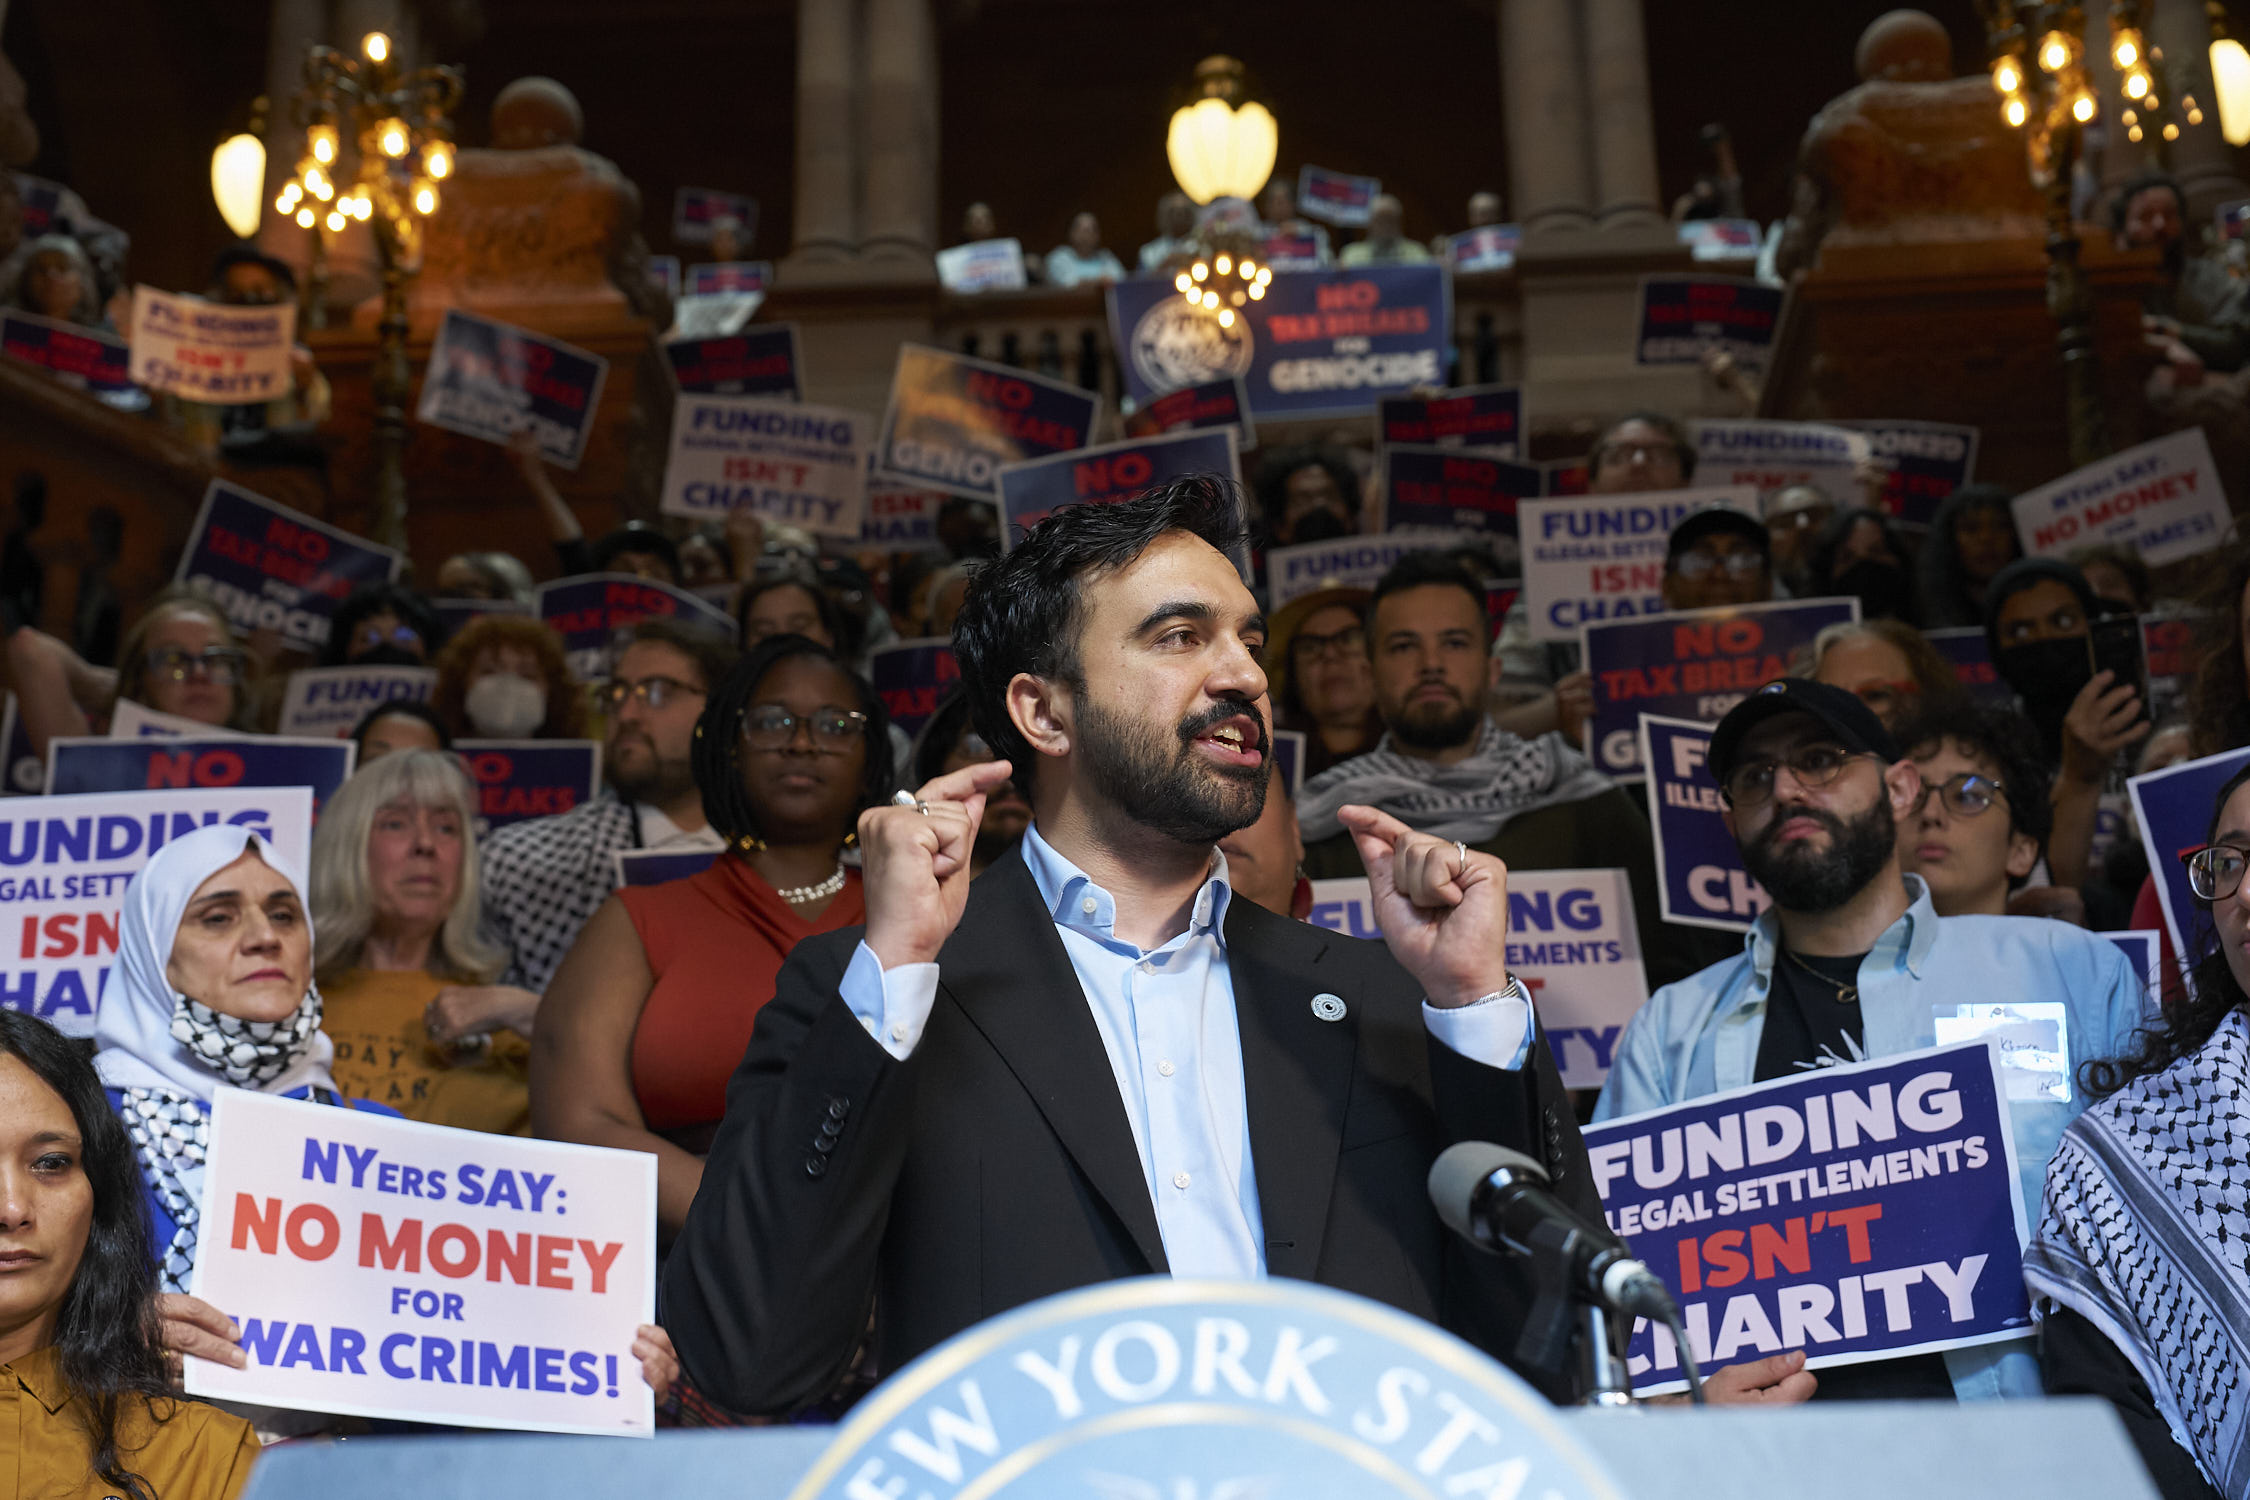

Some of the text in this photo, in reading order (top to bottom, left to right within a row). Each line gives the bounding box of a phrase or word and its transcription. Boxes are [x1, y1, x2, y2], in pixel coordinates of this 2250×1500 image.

[1315, 279, 1381, 312] NO
[966, 368, 1034, 410] NO
[1268, 348, 1441, 394] GENOCIDE
[692, 406, 852, 445] FUNDING
[723, 455, 809, 487] ISN'T
[891, 443, 997, 487] GENO
[1074, 451, 1153, 497] NO
[2034, 466, 2199, 550] NO MONEY
[266, 515, 331, 562] NO
[1591, 561, 1668, 594] ISN
[1673, 619, 1764, 660] NO
[1600, 664, 1680, 701] TAX
[147, 749, 246, 789] NO
[1502, 940, 1623, 966] EMENTS
[1586, 1071, 1965, 1200] FUNDING
[456, 1163, 567, 1216] SAY:
[1603, 1134, 1990, 1238] LEGAL SETTLEMENTS
[229, 1192, 624, 1295] NO MONEY
[1677, 1202, 1884, 1295] ISN'T
[390, 1286, 466, 1322] FOR
[229, 1314, 620, 1399] WAR CRIMES!
[842, 1315, 1560, 1500] EW YORK STA
